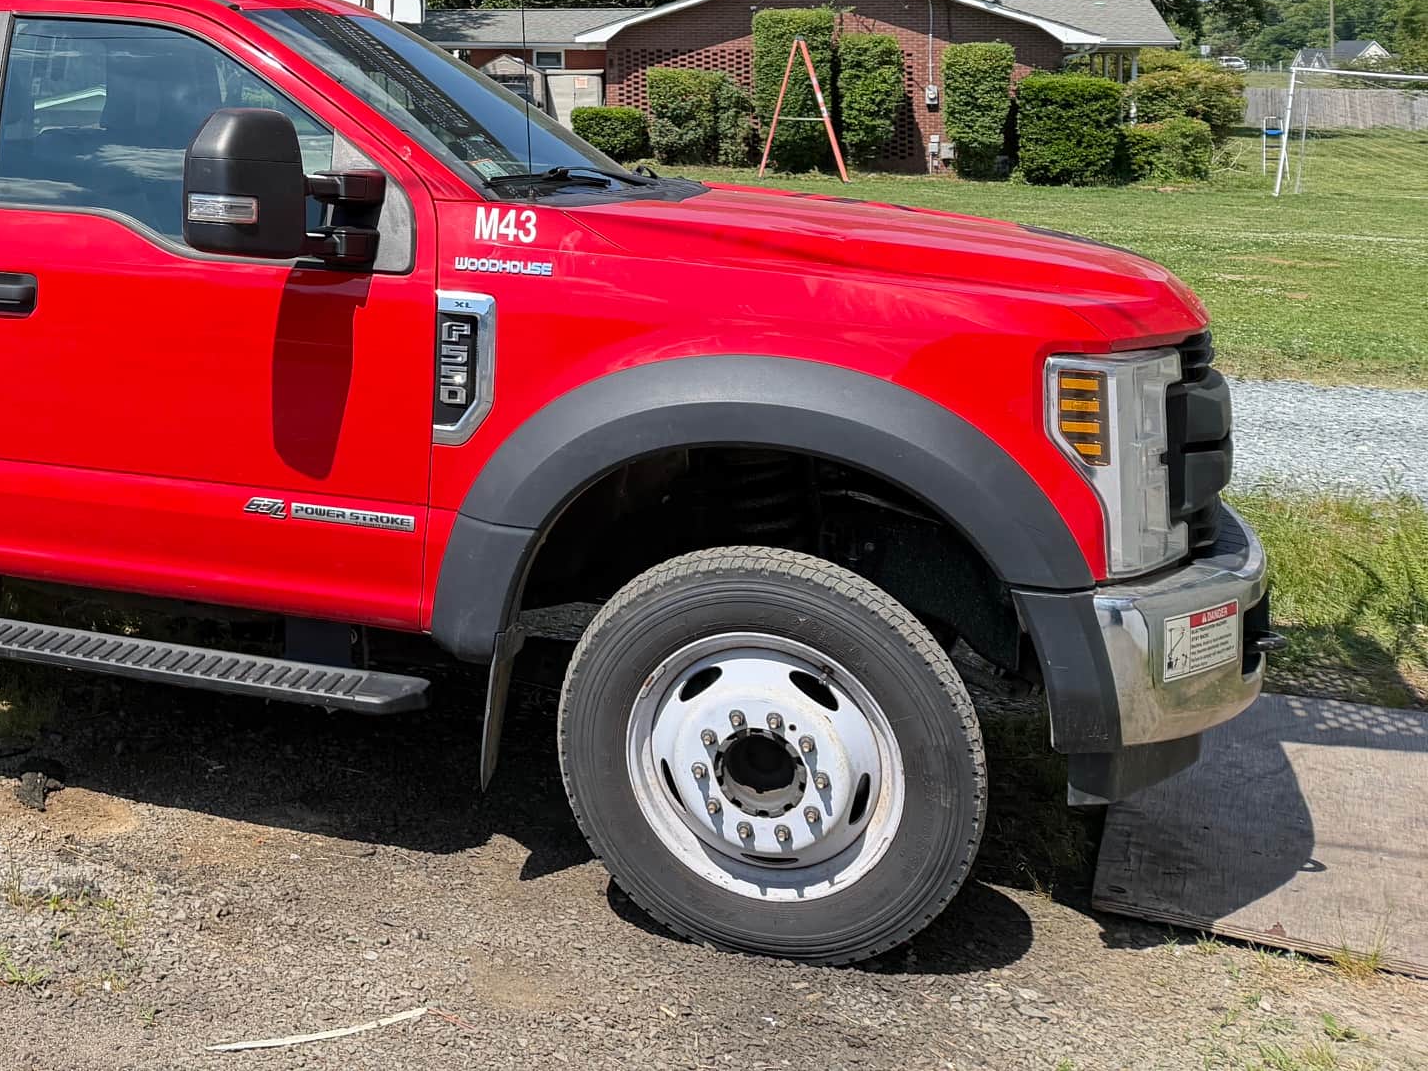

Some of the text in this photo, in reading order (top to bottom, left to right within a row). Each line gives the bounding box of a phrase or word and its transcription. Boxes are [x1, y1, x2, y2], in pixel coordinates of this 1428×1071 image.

[474, 206, 537, 244] M43
[454, 256, 553, 277] WOODHOUSE
[454, 300, 474, 309] XL
[294, 504, 346, 520] POWER
[349, 512, 411, 527] STROKE
